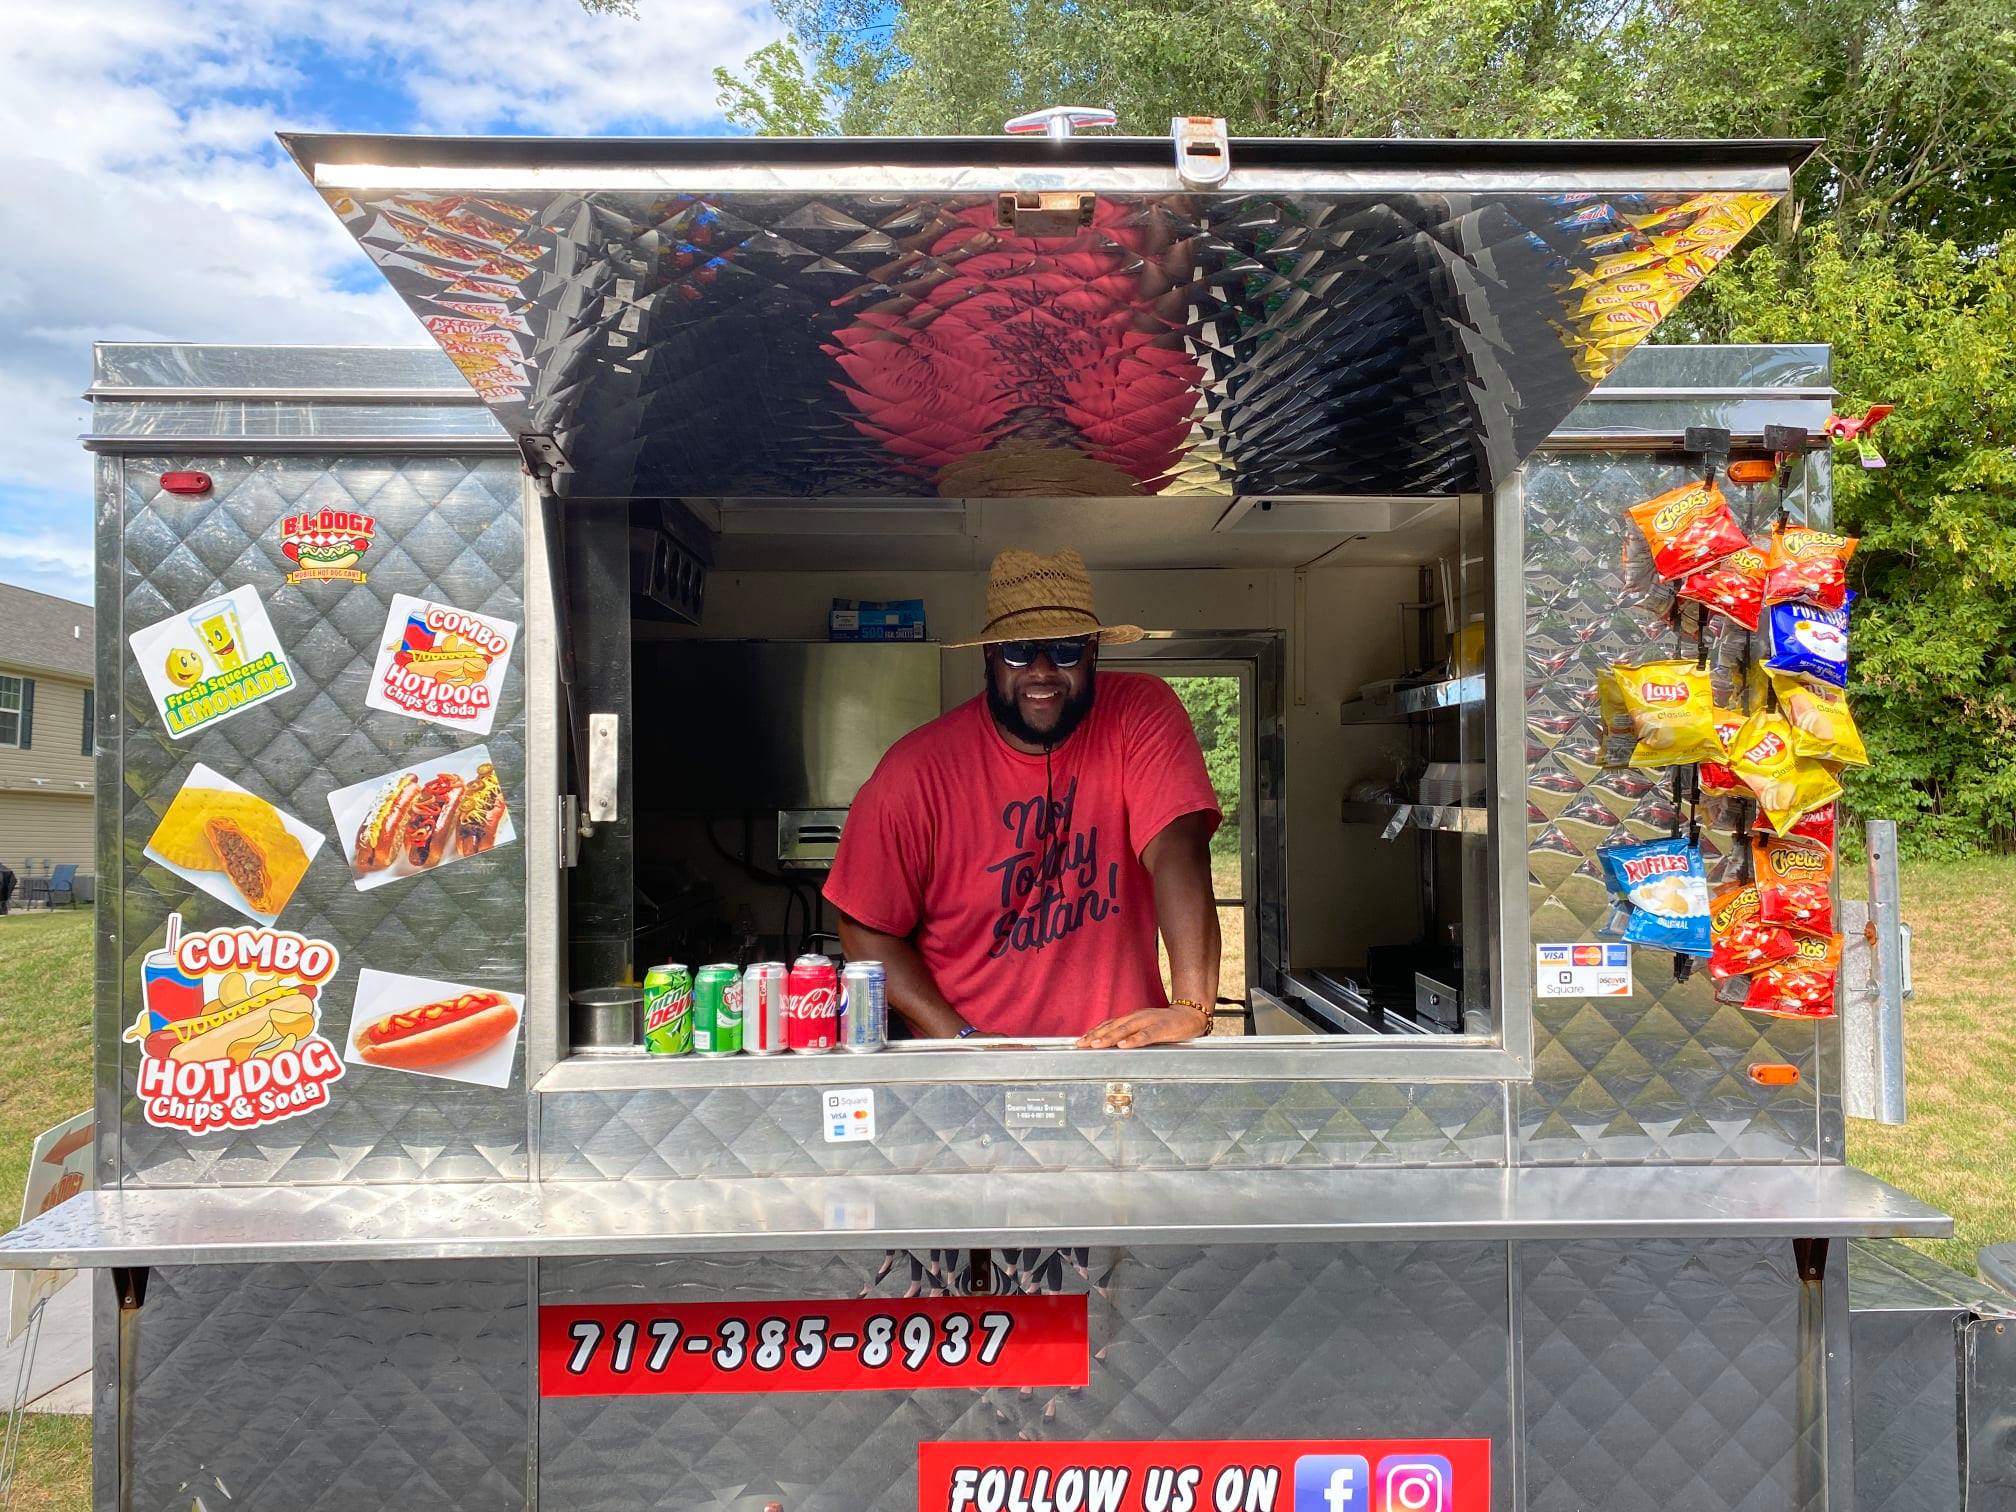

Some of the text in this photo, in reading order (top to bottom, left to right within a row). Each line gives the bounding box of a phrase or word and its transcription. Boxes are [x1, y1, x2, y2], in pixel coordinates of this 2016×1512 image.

[317, 511, 375, 538] DOGZ
[1654, 491, 1708, 531] Cheetos
[1784, 532, 1845, 554] Cheetos
[429, 610, 507, 654] COMBO
[862, 626, 883, 639] 500
[167, 654, 274, 709] Fresh Squeezed
[167, 664, 290, 733] LEMONADE
[386, 665, 489, 705] HOT DOG
[386, 686, 476, 716] Chips & Soda
[1657, 711, 1692, 720] Classic
[1002, 775, 1077, 849] Not
[986, 827, 1097, 908] Today
[1625, 856, 1688, 883] RUFFLES
[181, 932, 330, 979] COMBO
[1544, 952, 1564, 960] VISA
[1546, 984, 1585, 996] Square
[144, 1042, 336, 1097] HOT DOG
[152, 1081, 320, 1126] Chips & Soda
[830, 1112, 847, 1120] VISA
[840, 1097, 868, 1105] Square
[567, 1311, 1014, 1374] 717-385-8937
[951, 1466, 1280, 1512] FOLLOW US ON
